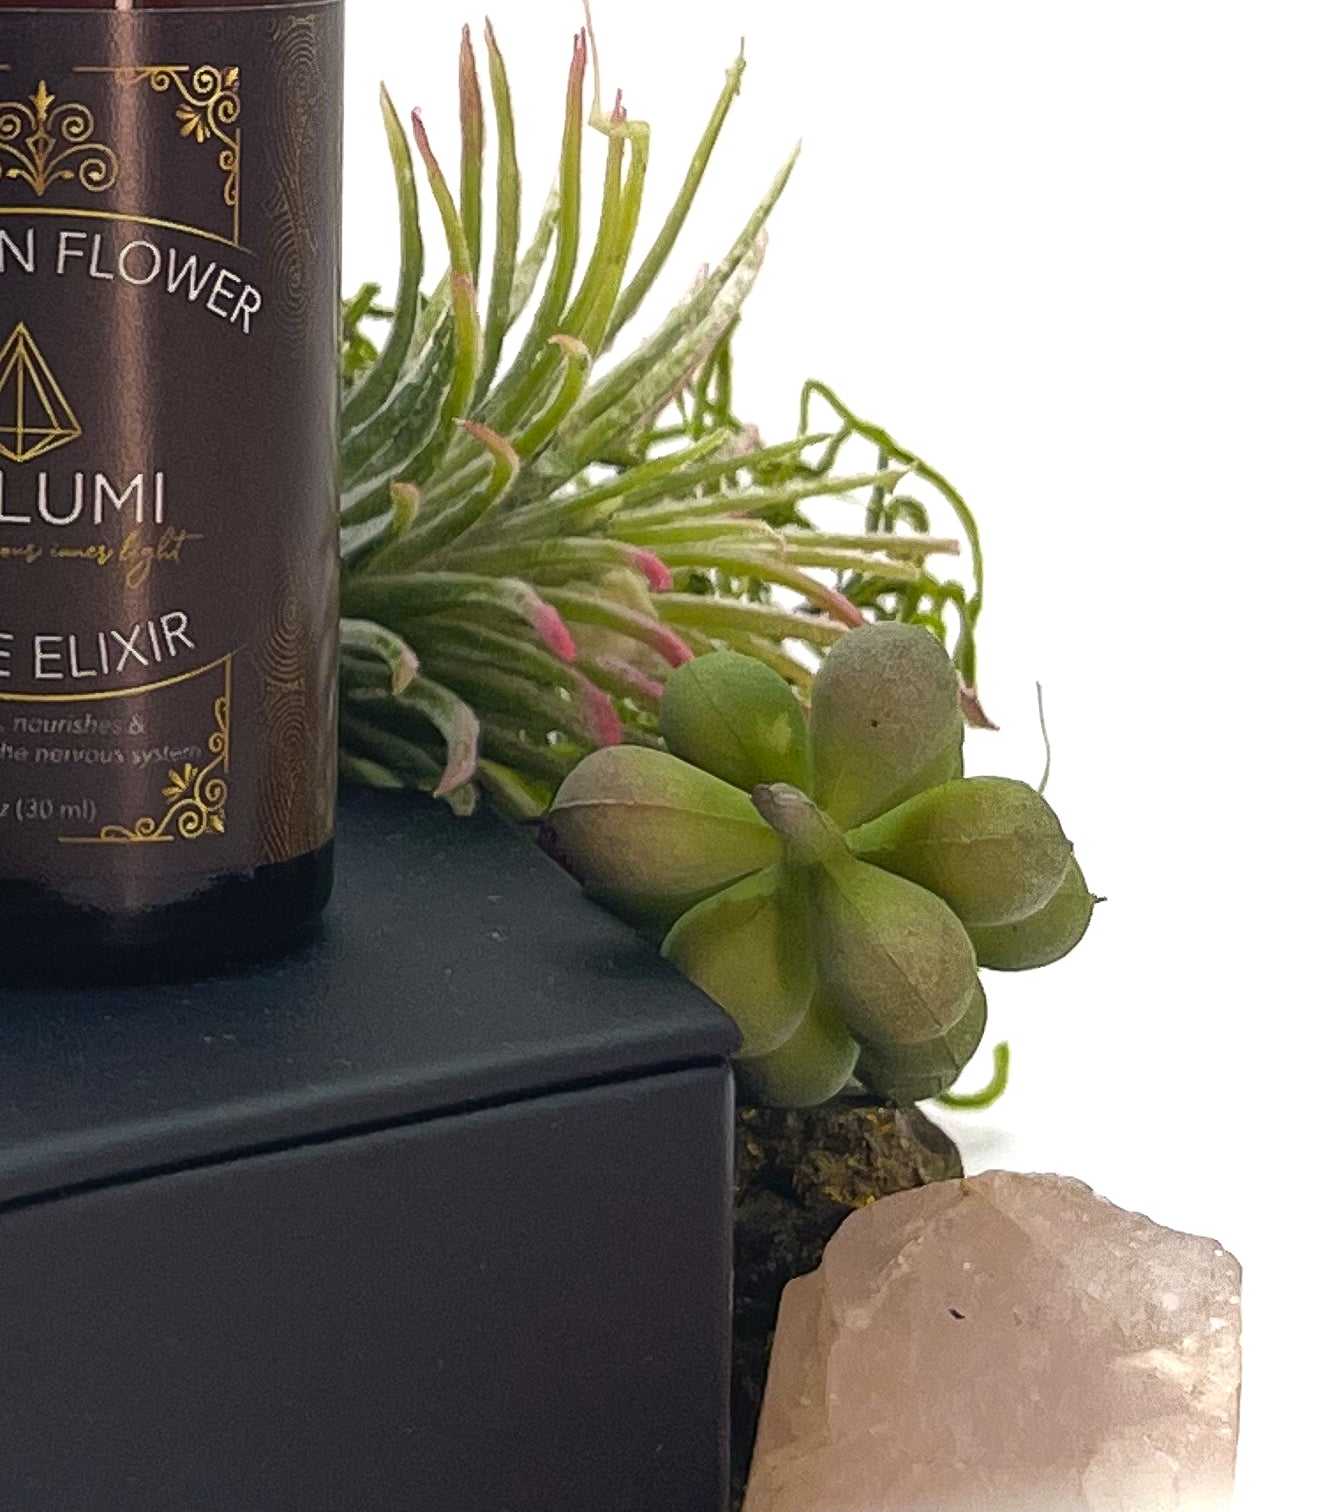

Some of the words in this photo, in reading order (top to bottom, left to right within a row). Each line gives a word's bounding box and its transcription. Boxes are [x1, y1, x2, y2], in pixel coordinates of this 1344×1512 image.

[57, 231, 263, 334] FLOWER
[33, 610, 196, 679] ELIXIR
[128, 713, 146, 735] &
[15, 797, 54, 821] (30
[59, 798, 98, 822] ml)
